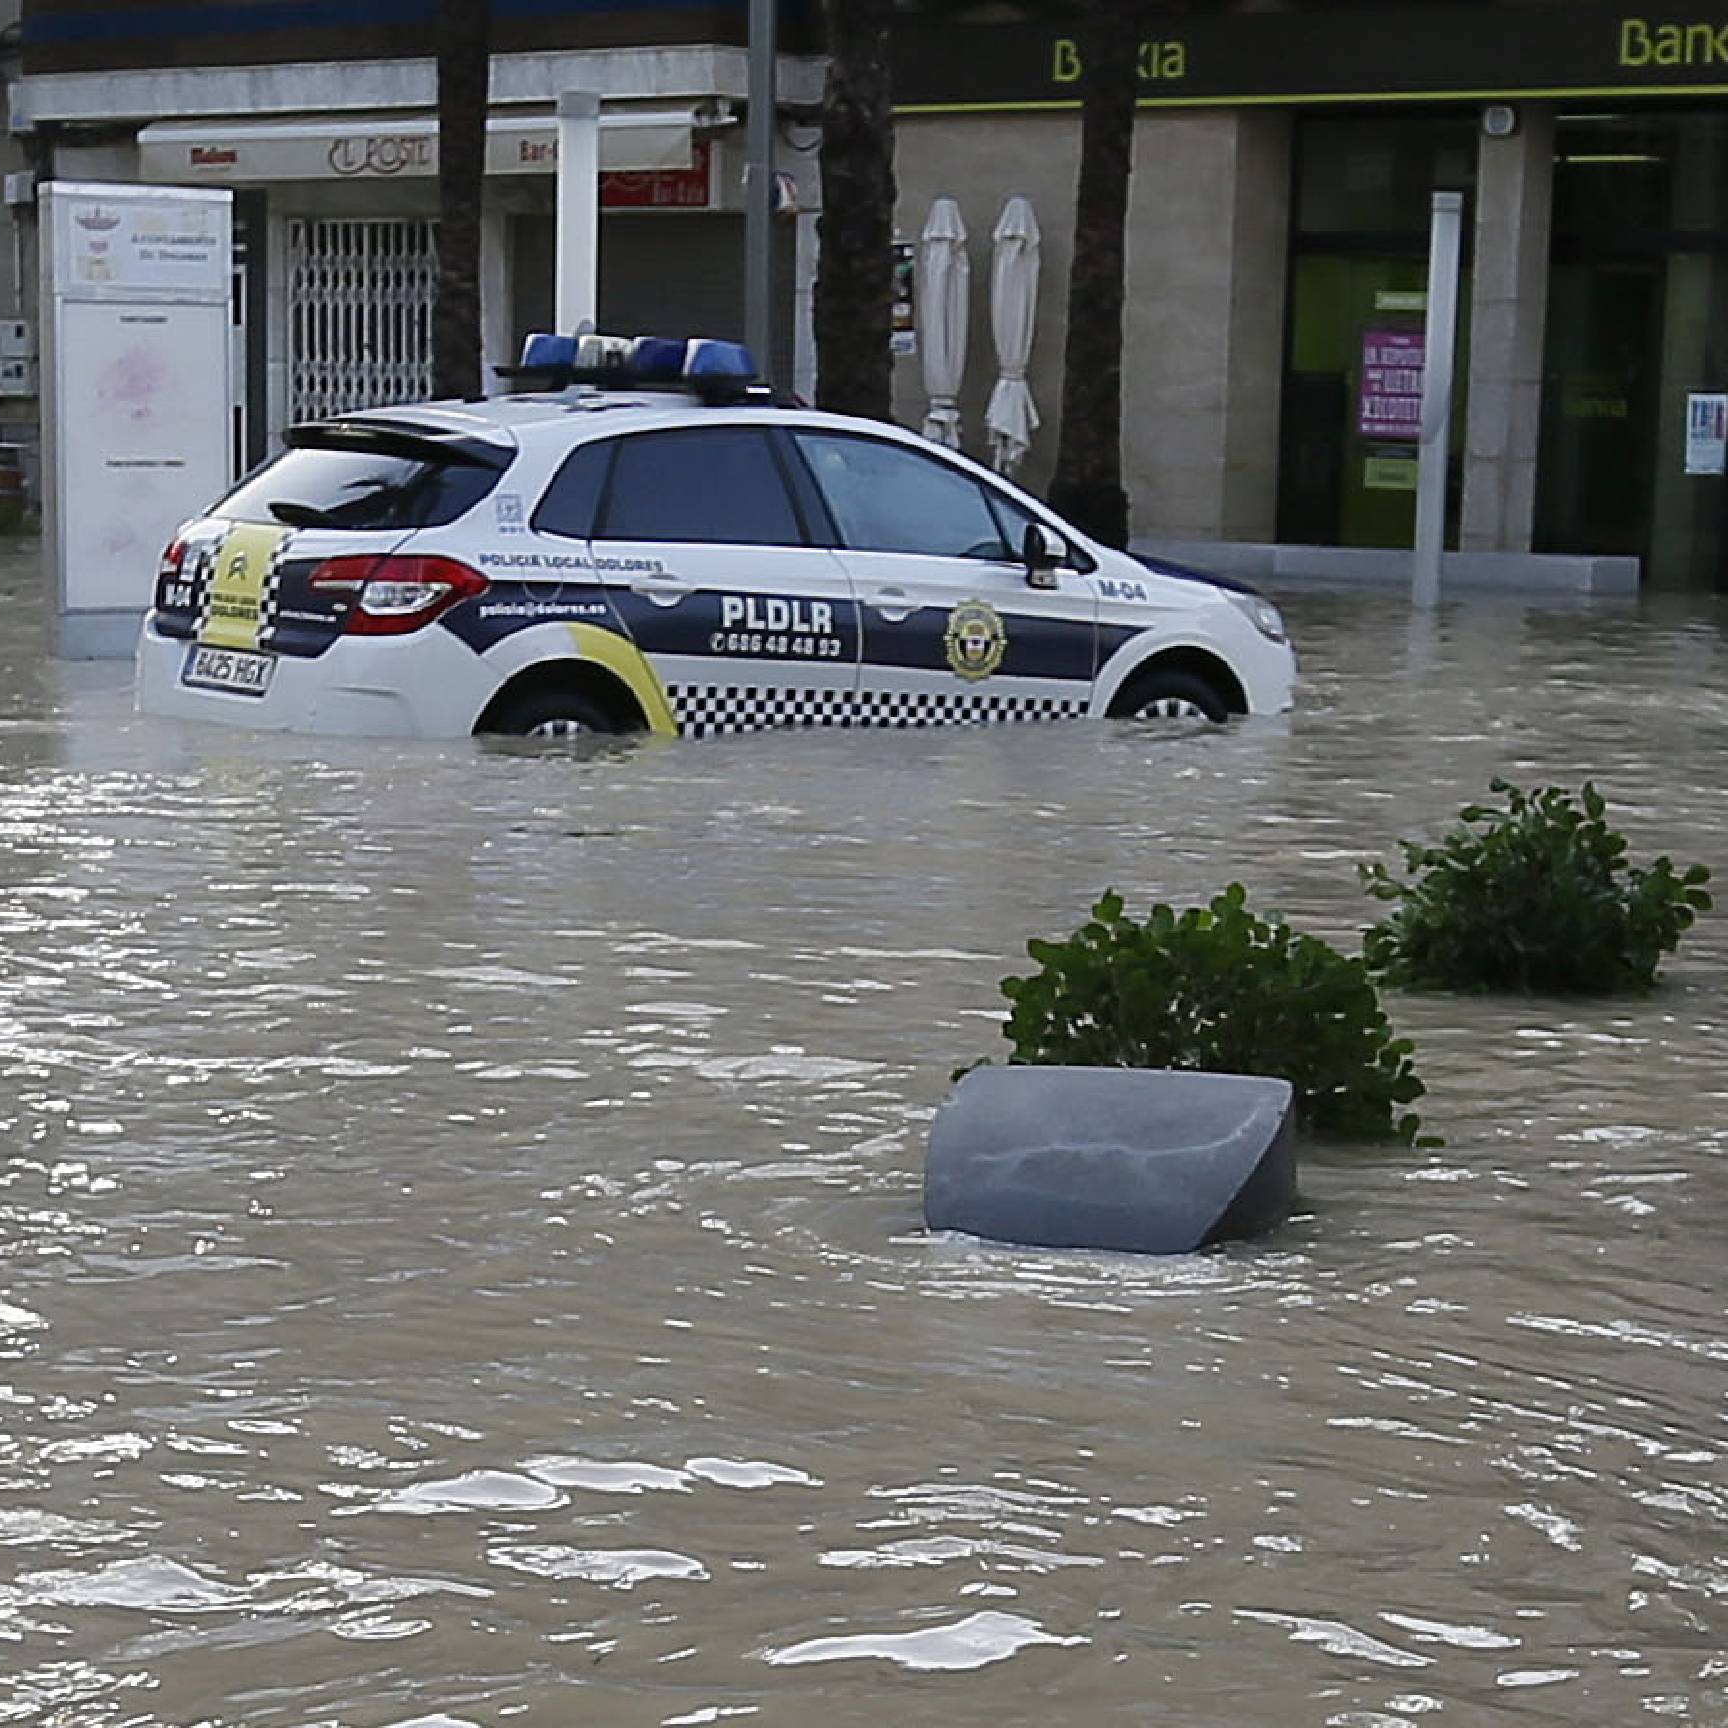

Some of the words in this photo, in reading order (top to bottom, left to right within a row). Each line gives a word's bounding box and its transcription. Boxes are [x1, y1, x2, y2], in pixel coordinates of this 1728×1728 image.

[1052, 39, 1185, 81] Bia
[544, 555, 592, 570] LOCAL
[594, 558, 665, 573] DOLORES
[1098, 578, 1148, 602] M-04
[210, 605, 259, 621] DOLORES
[479, 601, 607, 619] policia@dolores.es
[722, 595, 832, 634] PLDLR
[765, 635, 788, 653] 48
[792, 637, 814, 655] 48
[195, 650, 234, 679] 6425
[232, 657, 268, 685] HGX
